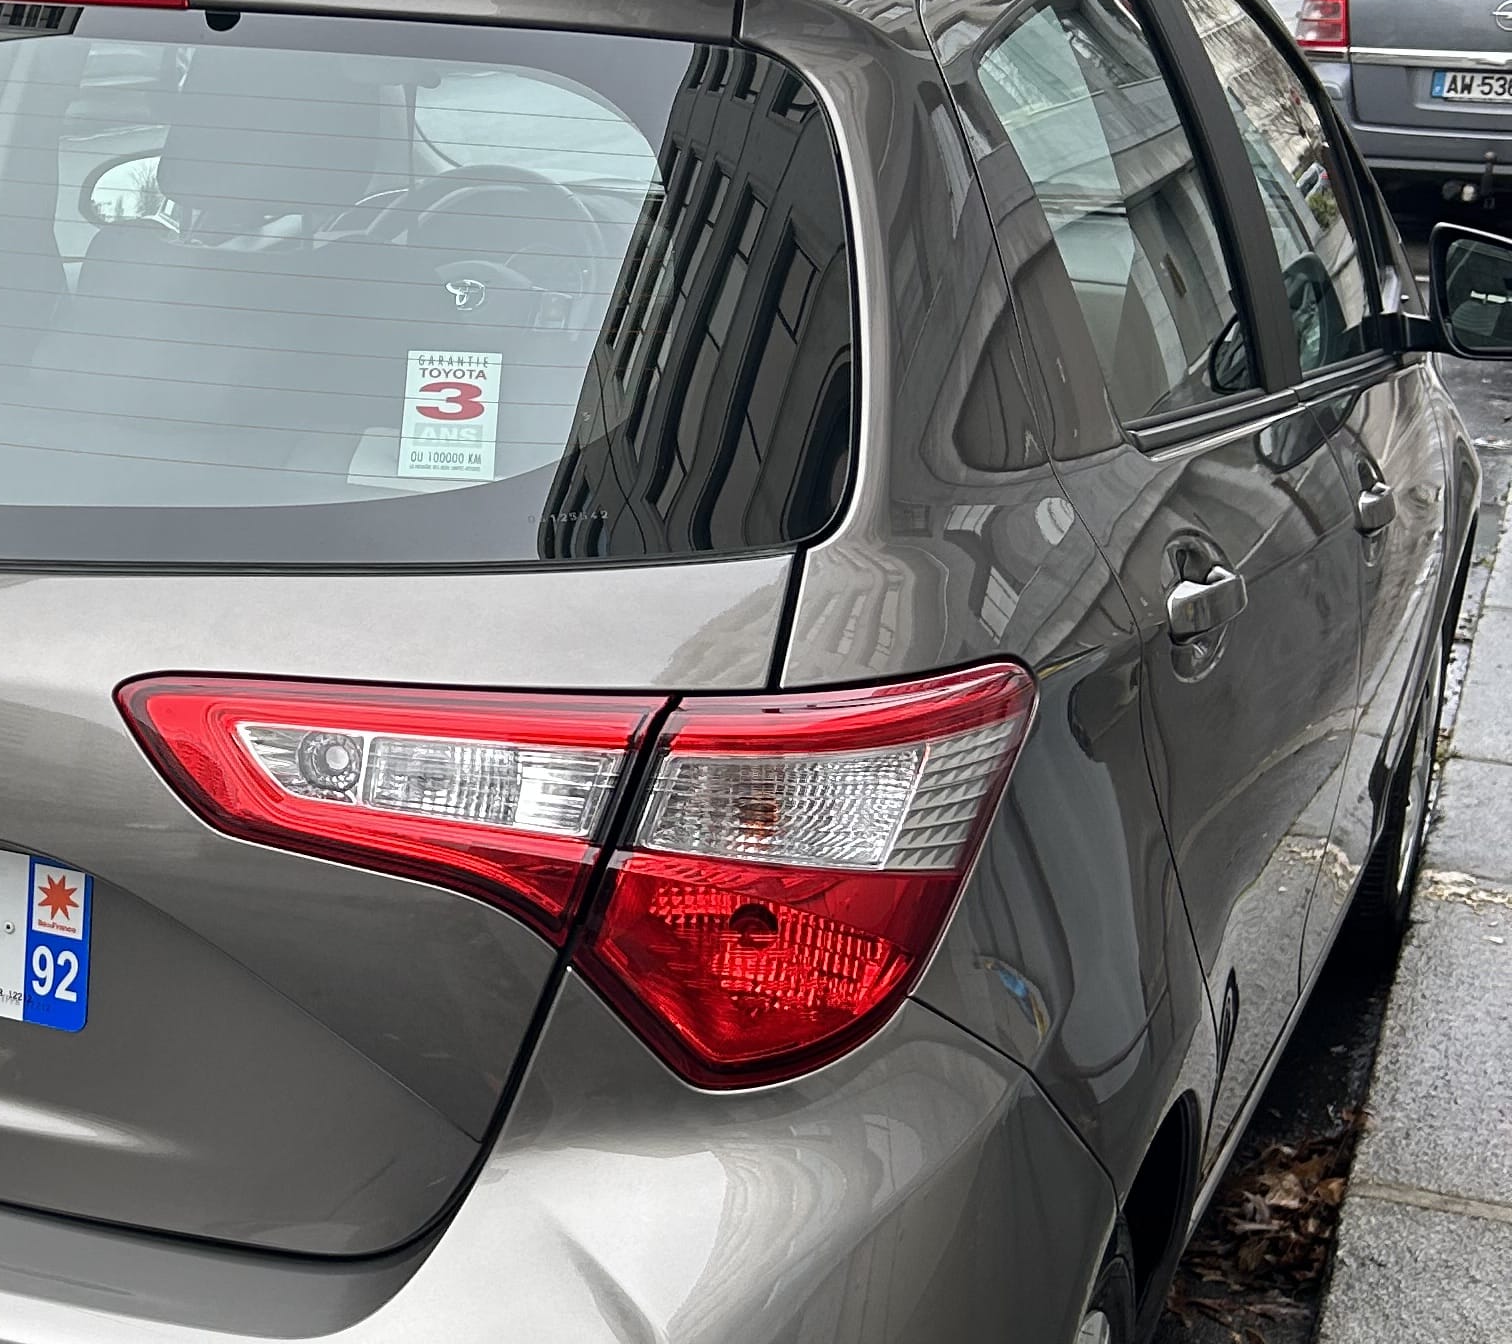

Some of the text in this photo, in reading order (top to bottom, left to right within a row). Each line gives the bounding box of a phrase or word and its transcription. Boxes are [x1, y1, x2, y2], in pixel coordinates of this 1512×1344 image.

[418, 354, 489, 369] GARANTIE
[418, 367, 487, 380] TOYOTA
[415, 381, 485, 421] 3
[419, 425, 479, 444] ANS
[410, 451, 482, 465] OU 100000 KM
[31, 945, 79, 1003] 92
